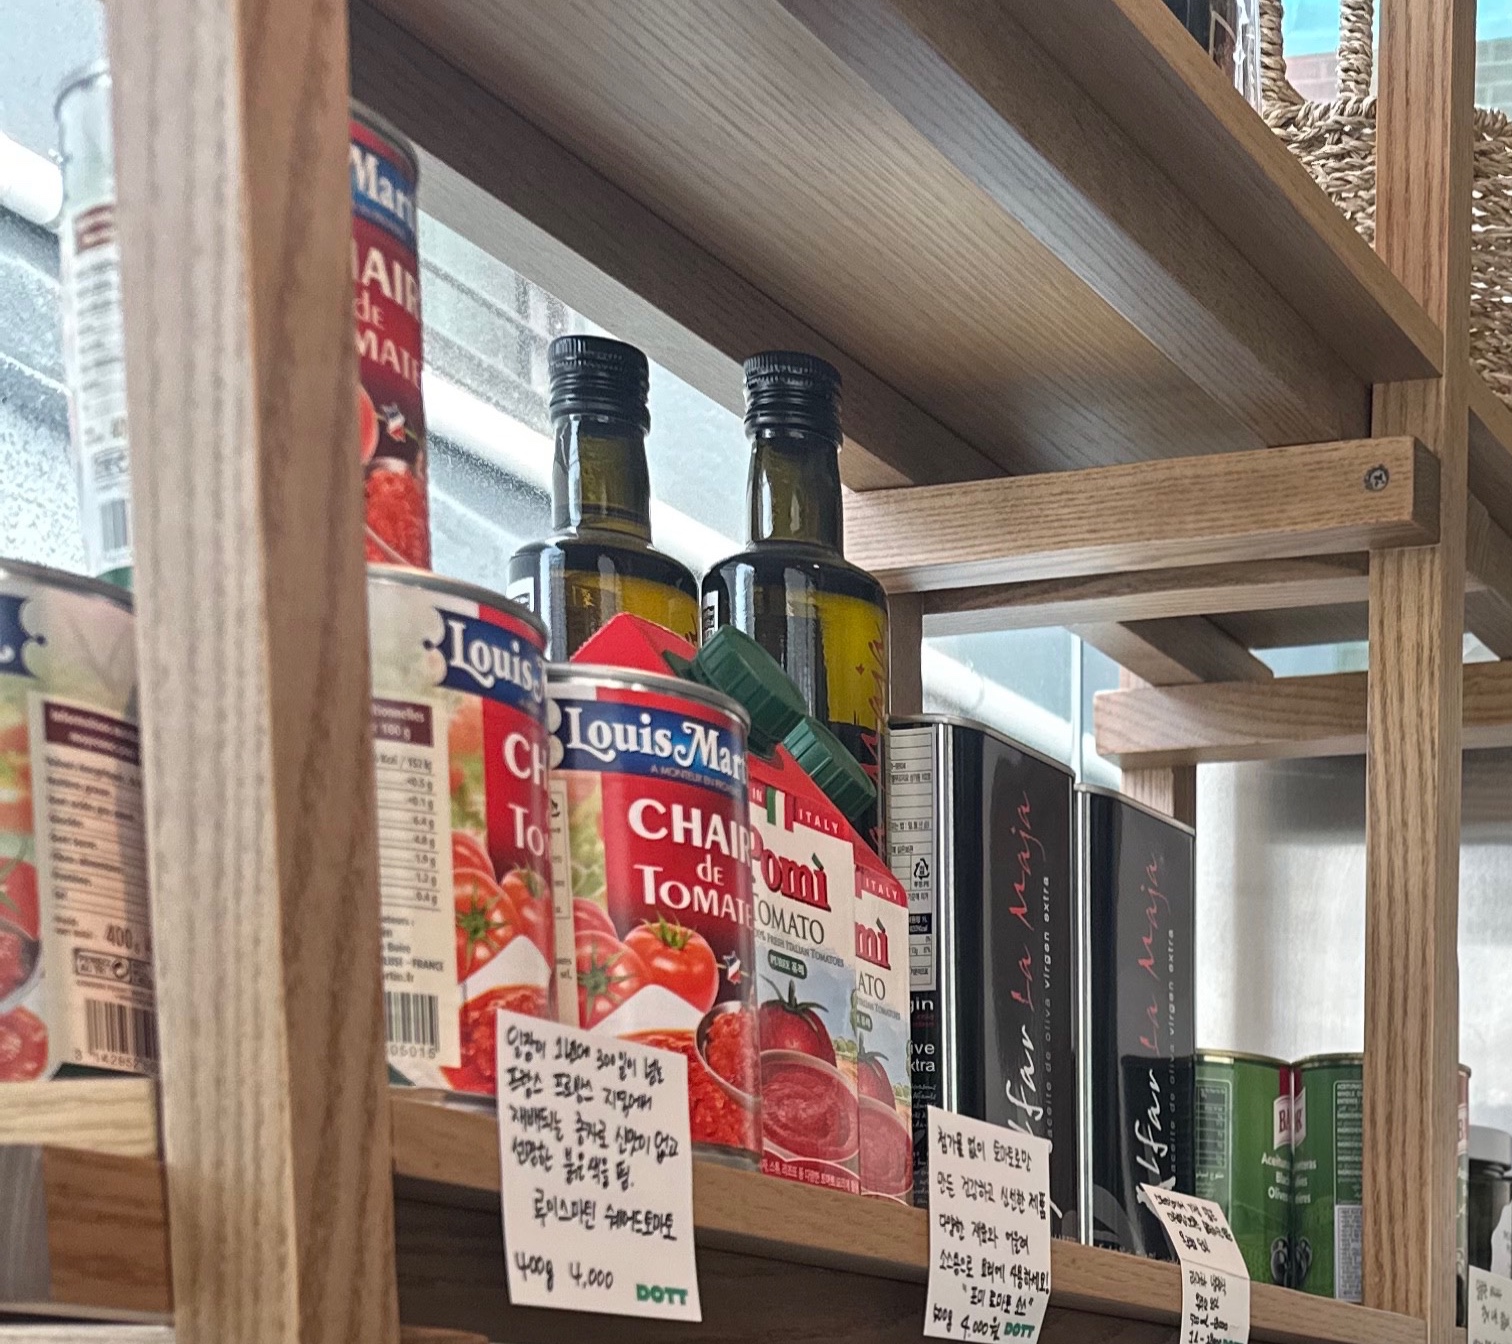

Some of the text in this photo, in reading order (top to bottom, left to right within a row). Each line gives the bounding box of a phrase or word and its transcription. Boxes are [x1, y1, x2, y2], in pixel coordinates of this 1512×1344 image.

[448, 618, 533, 692] Louis
[564, 706, 674, 763] Louis
[628, 798, 750, 868] CHAIR
[799, 809, 840, 835] ITALY
[865, 877, 899, 901] ITALY
[1042, 875, 1051, 923] extra
[1167, 930, 1175, 975] extra
[857, 970, 887, 1001] ATO
[936, 1124, 964, 1159] 첨가물
[967, 1135, 987, 1162] 없이
[936, 1171, 956, 1200] 만든
[960, 1175, 996, 1204] 건강하고
[938, 1213, 966, 1242] 다양한
[515, 1250, 555, 1292] 400g
[635, 1282, 689, 1306] DOTT
[1003, 1320, 1036, 1340] DOTT
